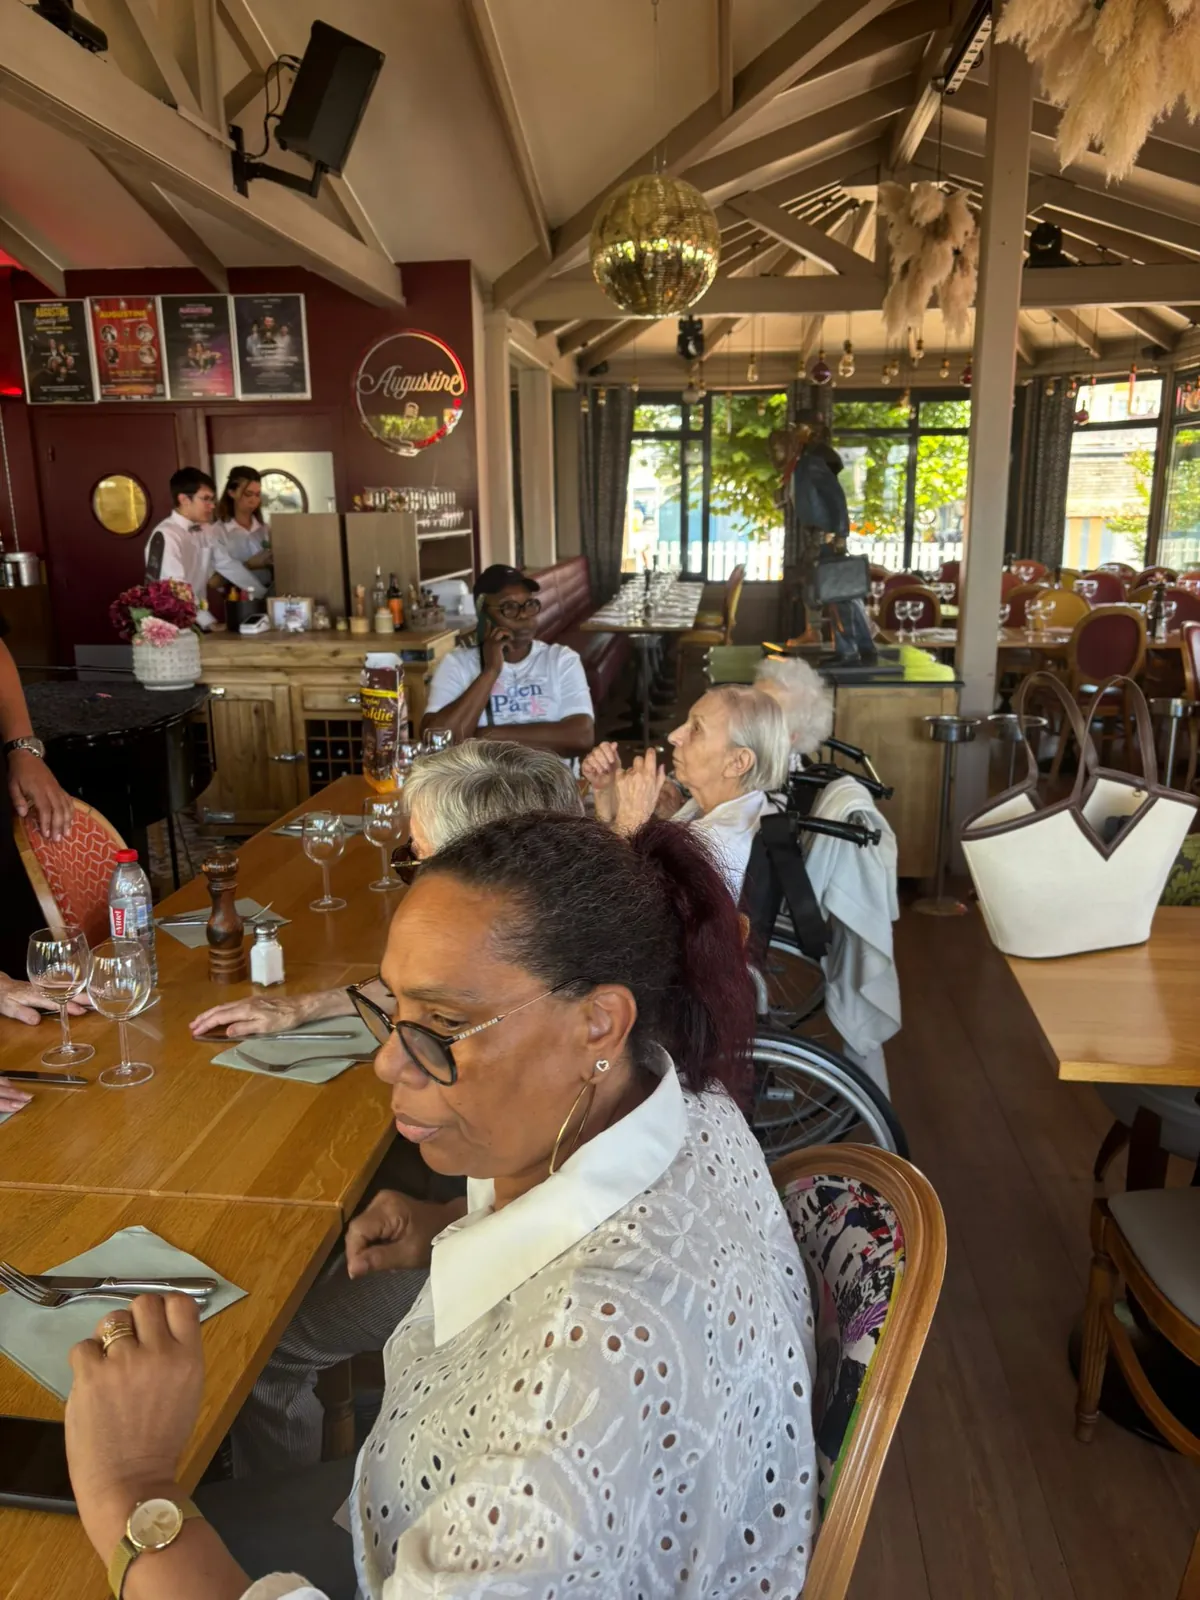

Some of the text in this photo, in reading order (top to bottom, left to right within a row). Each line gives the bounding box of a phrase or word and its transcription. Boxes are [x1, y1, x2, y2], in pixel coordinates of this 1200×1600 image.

[99, 310, 148, 319] AUGUSTINE
[356, 365, 465, 400] Augustine
[361, 705, 394, 722] oldie
[492, 694, 547, 715] Park
